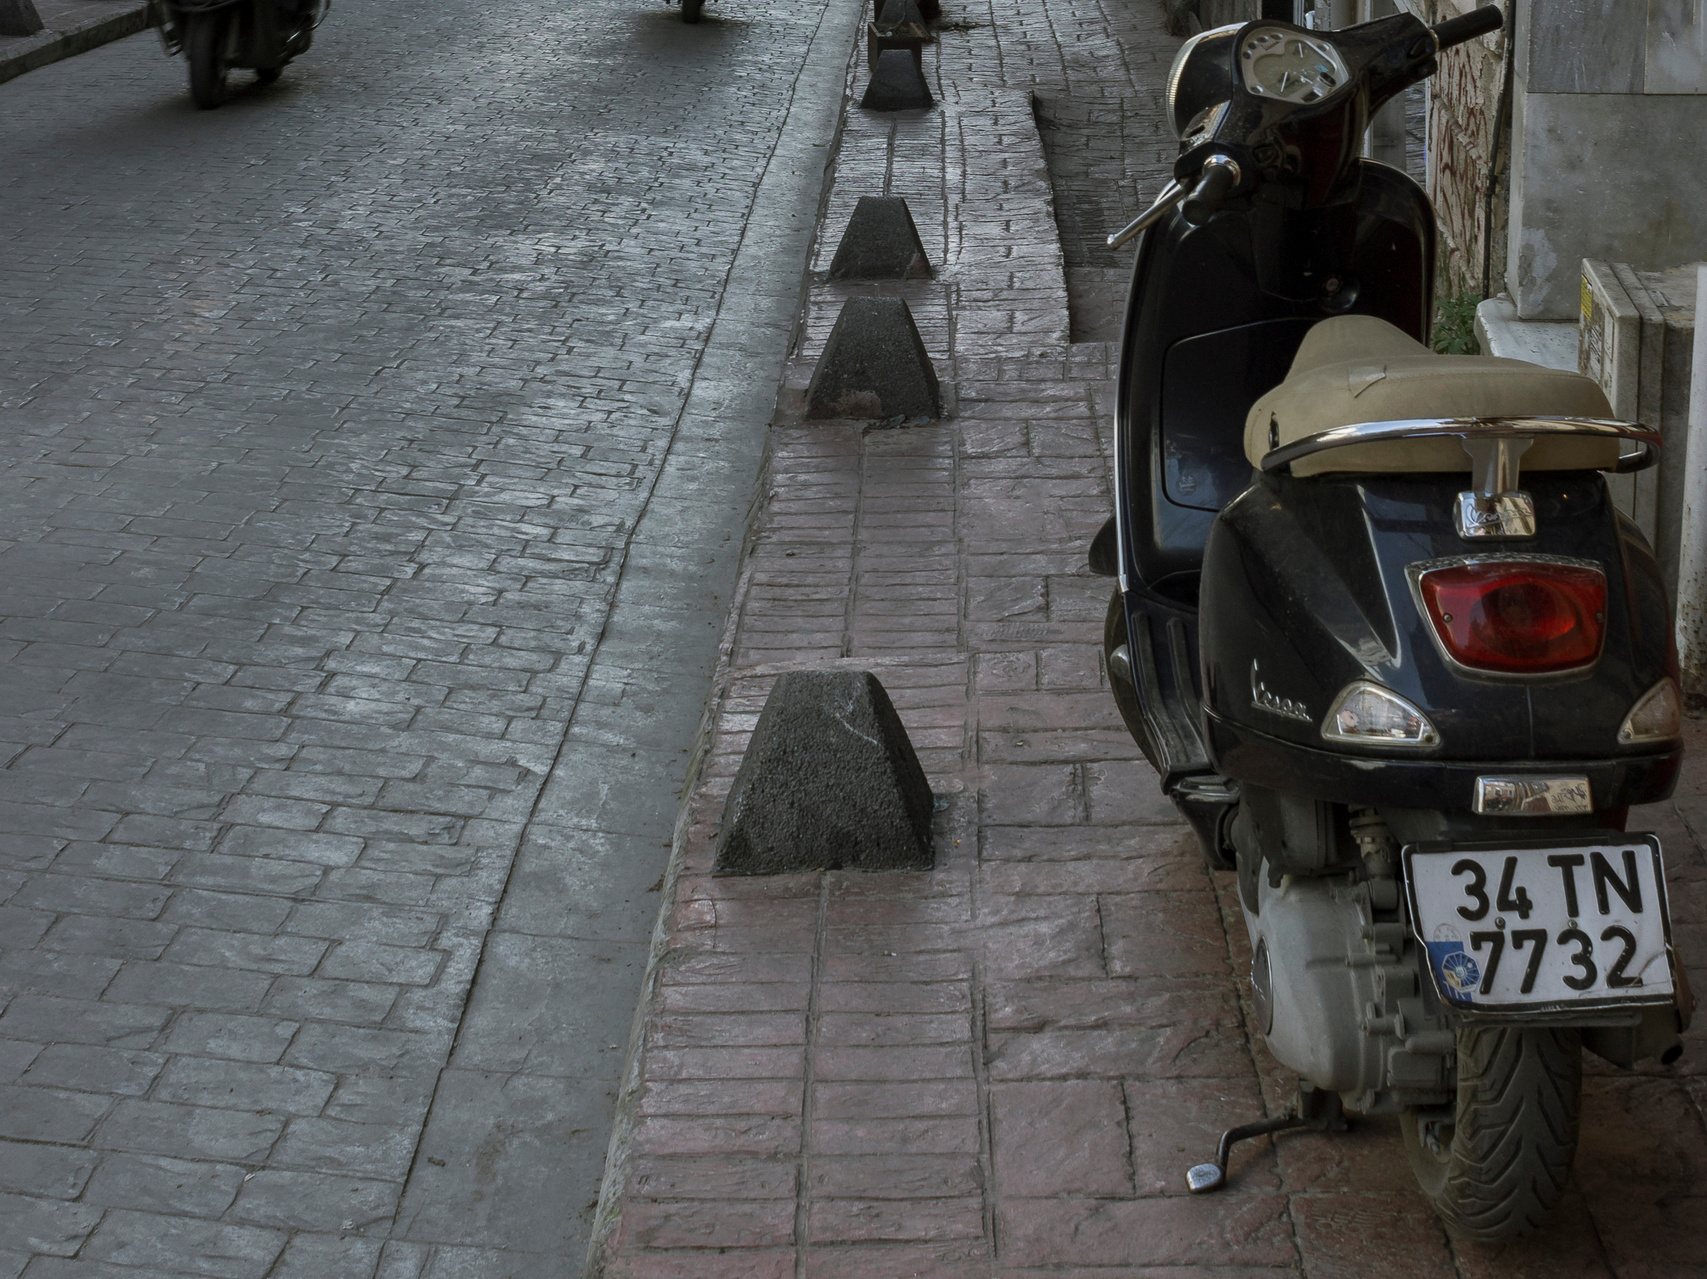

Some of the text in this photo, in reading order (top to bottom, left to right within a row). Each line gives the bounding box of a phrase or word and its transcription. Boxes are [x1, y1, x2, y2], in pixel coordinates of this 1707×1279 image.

[1450, 850, 1644, 921] 34 TN
[1469, 925, 1644, 995] 7732
